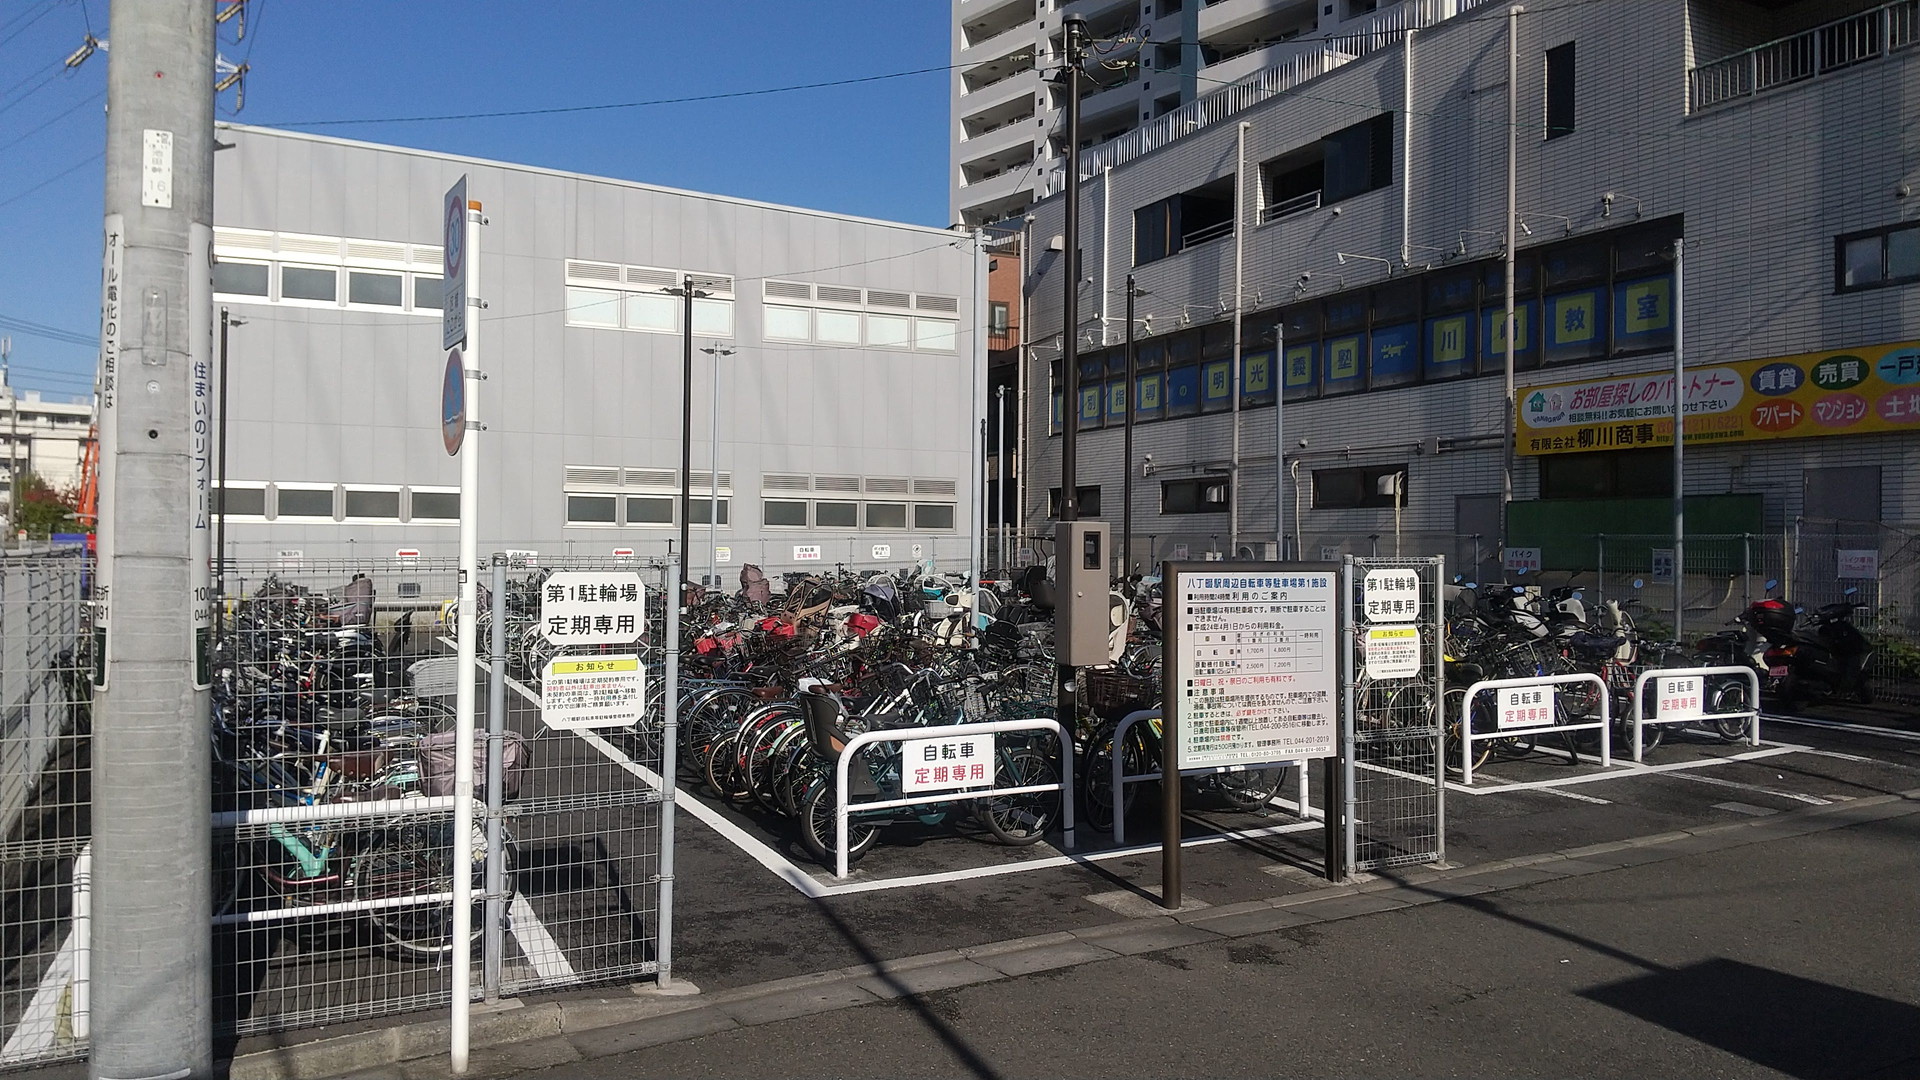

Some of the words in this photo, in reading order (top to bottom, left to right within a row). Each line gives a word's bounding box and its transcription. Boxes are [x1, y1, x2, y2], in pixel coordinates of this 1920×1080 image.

[450, 217, 461, 256] 30
[104, 231, 119, 409] オール電化のご相談は
[1818, 360, 1860, 385] 売買
[1879, 354, 1920, 378] 一戸
[1758, 367, 1797, 391] 賃貸
[1756, 403, 1801, 426] アパート
[1815, 399, 1866, 422] マンション
[194, 361, 207, 530] 住まいのリフォーム
[1529, 436, 1576, 451] 有限会社
[1577, 423, 1654, 449] 柳川商事
[1511, 550, 1533, 558] バイク
[546, 583, 638, 603] 第1駐輪場
[1366, 577, 1416, 591] 第1駐輪場
[1232, 591, 1288, 601] 利用のご案内
[1368, 599, 1415, 615] 定期専用
[547, 615, 635, 636] 定期専用
[1194, 614, 1227, 622] できません。
[575, 662, 615, 672] お知らせ
[1194, 688, 1225, 697] 注意事項
[1667, 680, 1694, 694] 自転車
[1510, 691, 1543, 706] 自転車
[1661, 697, 1697, 711] 定期専用
[1504, 707, 1548, 723] 定期専用
[924, 741, 975, 761] 自転車
[914, 763, 984, 785] 定期専用
